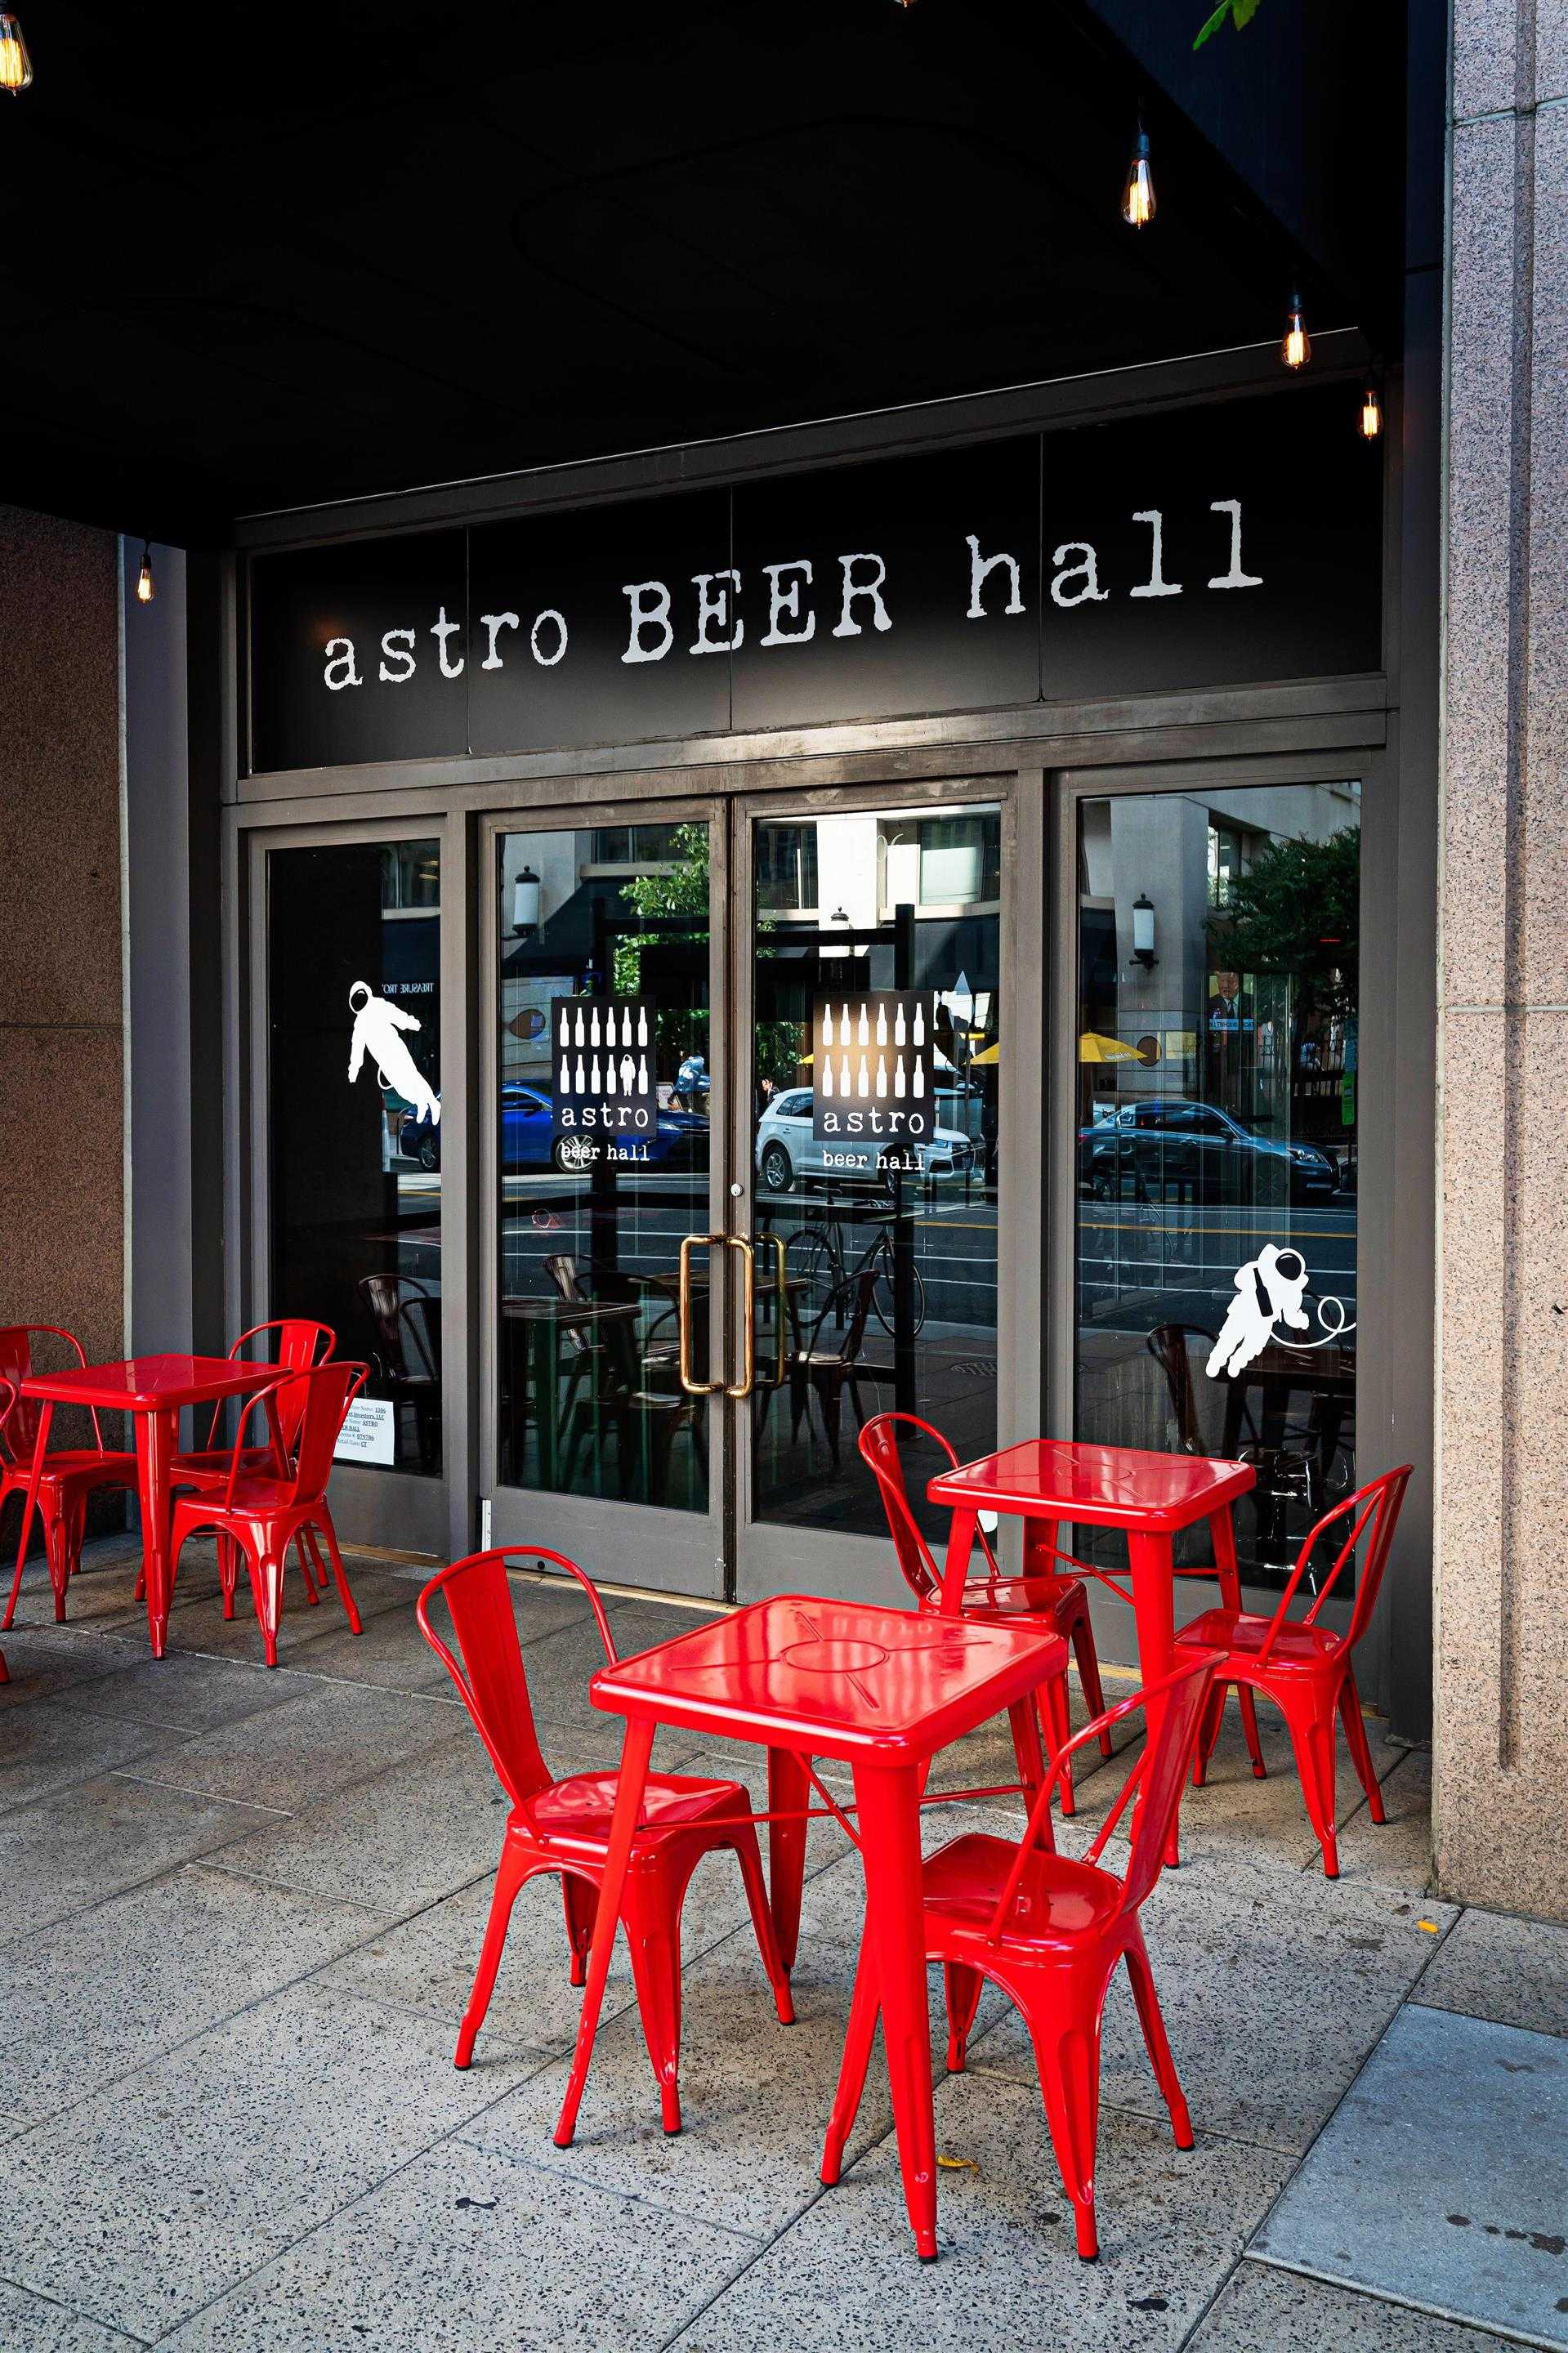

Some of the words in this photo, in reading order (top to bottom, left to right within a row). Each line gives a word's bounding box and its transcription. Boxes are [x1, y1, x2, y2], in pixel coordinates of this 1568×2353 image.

[324, 606, 569, 690] astro
[621, 553, 893, 663] BEER
[965, 499, 1263, 618] hall
[561, 1102, 649, 1127] astro
[823, 1106, 925, 1134] astro
[561, 1143, 600, 1160] beer
[606, 1144, 650, 1162] hall
[822, 1150, 868, 1169] beer
[875, 1151, 926, 1171] hall
